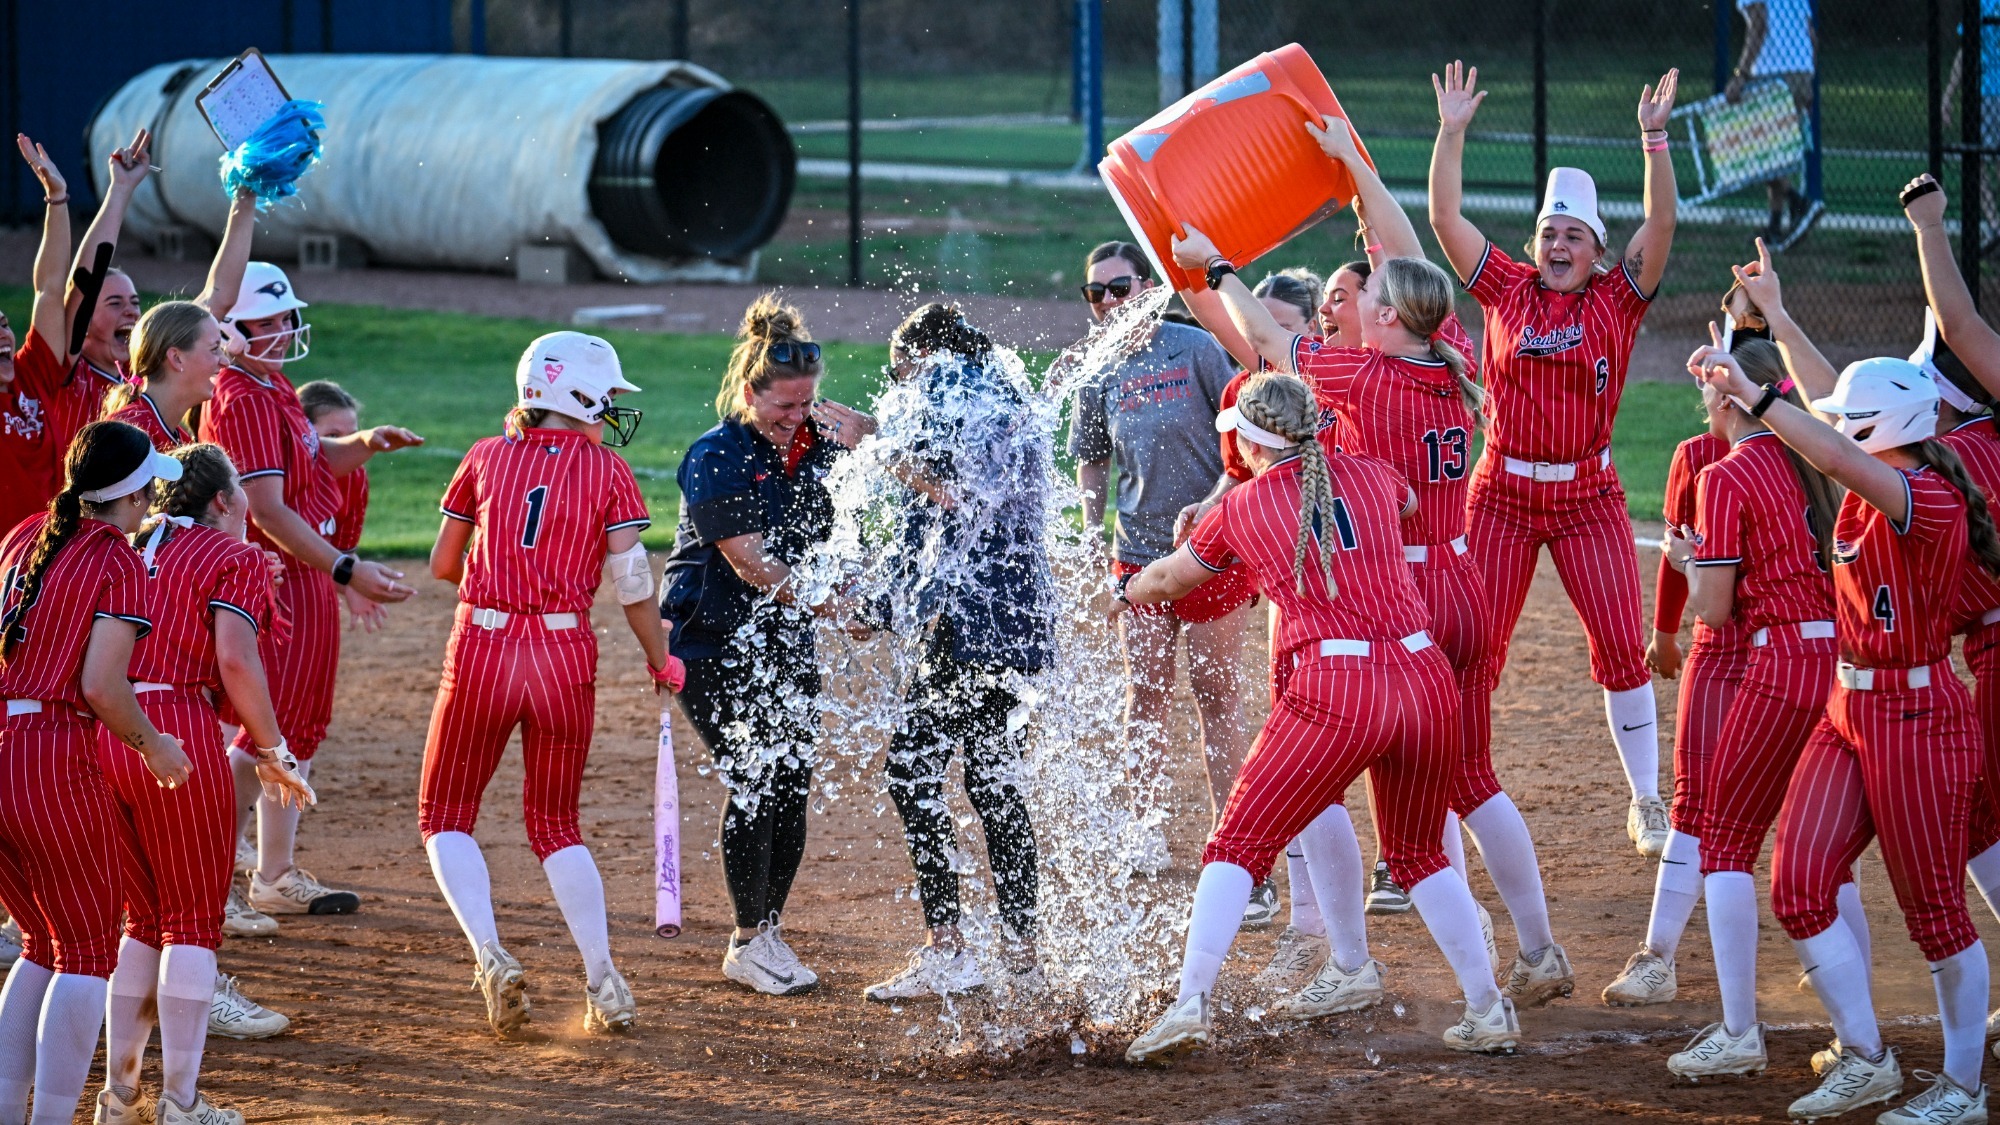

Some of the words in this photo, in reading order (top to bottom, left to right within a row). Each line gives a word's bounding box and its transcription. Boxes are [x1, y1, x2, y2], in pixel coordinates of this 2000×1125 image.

[1540, 342, 1571, 356] INDIANA
[1595, 356, 1609, 396] 6
[1422, 426, 1468, 483] 13
[521, 485, 548, 549] 1
[1872, 584, 1895, 633] 4
[1302, 979, 1338, 1003] N
[1642, 969, 1666, 991] N
[211, 1001, 245, 1025] N
[1693, 1040, 1723, 1062] N
[1829, 1073, 1871, 1098] N
